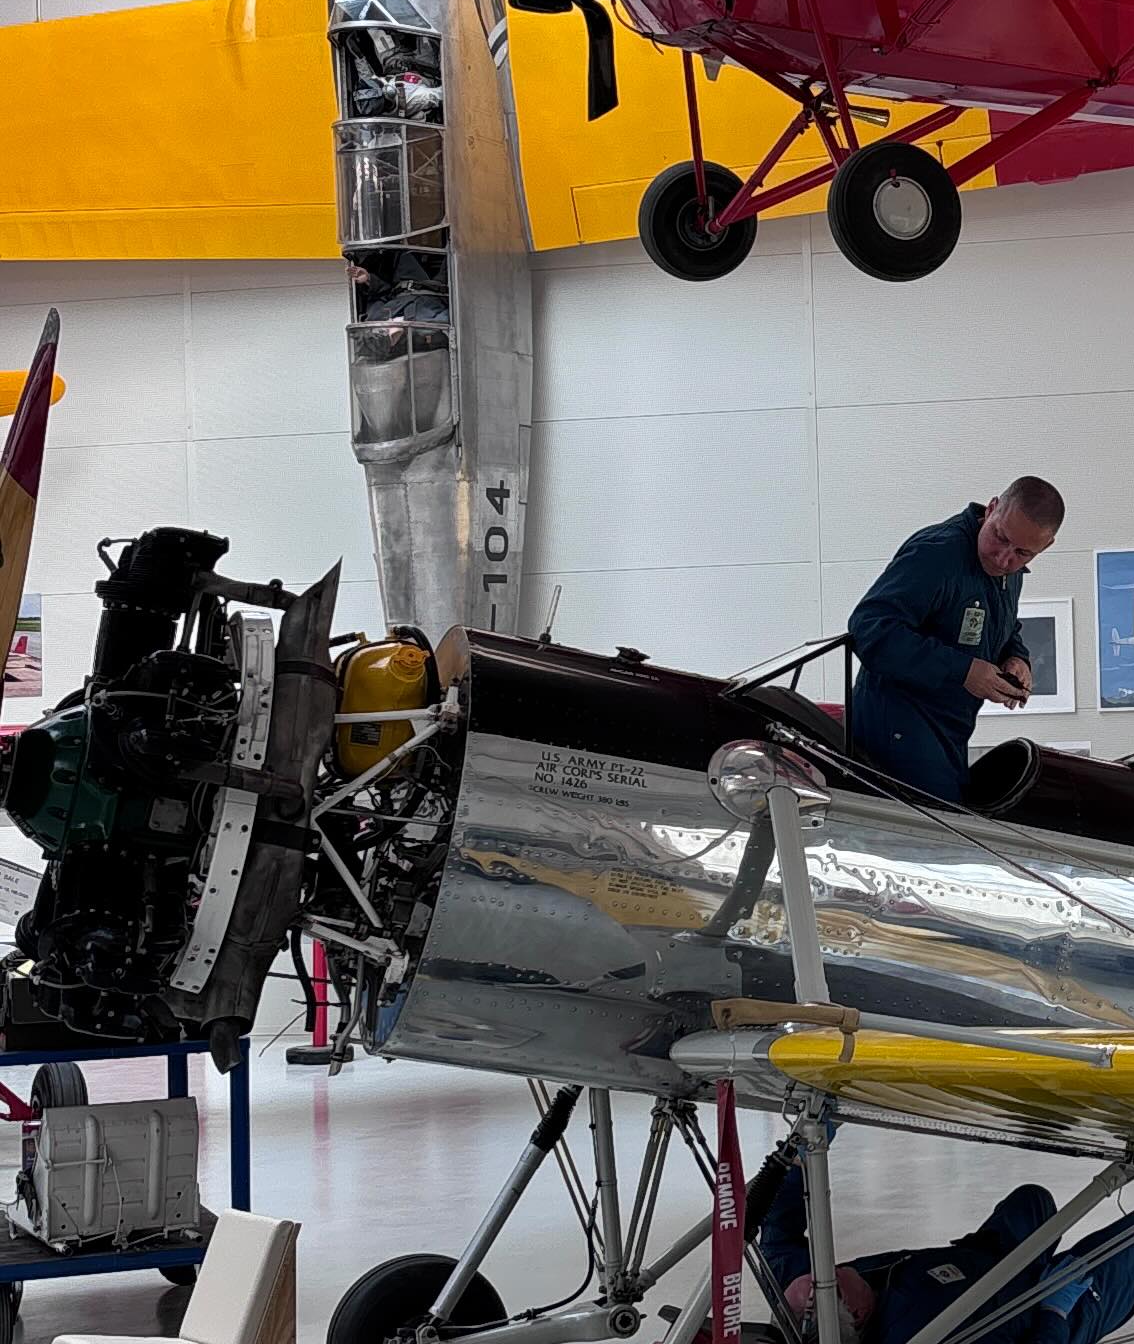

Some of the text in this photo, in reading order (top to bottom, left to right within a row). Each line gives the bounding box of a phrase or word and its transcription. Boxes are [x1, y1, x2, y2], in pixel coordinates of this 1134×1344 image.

[536, 761, 648, 789] AIR CORPS SERIAL
[568, 755, 606, 771] ARMY
[611, 762, 645, 777] PT-22
[561, 776, 588, 790] 1426
[722, 1272, 742, 1338] BEFORE
